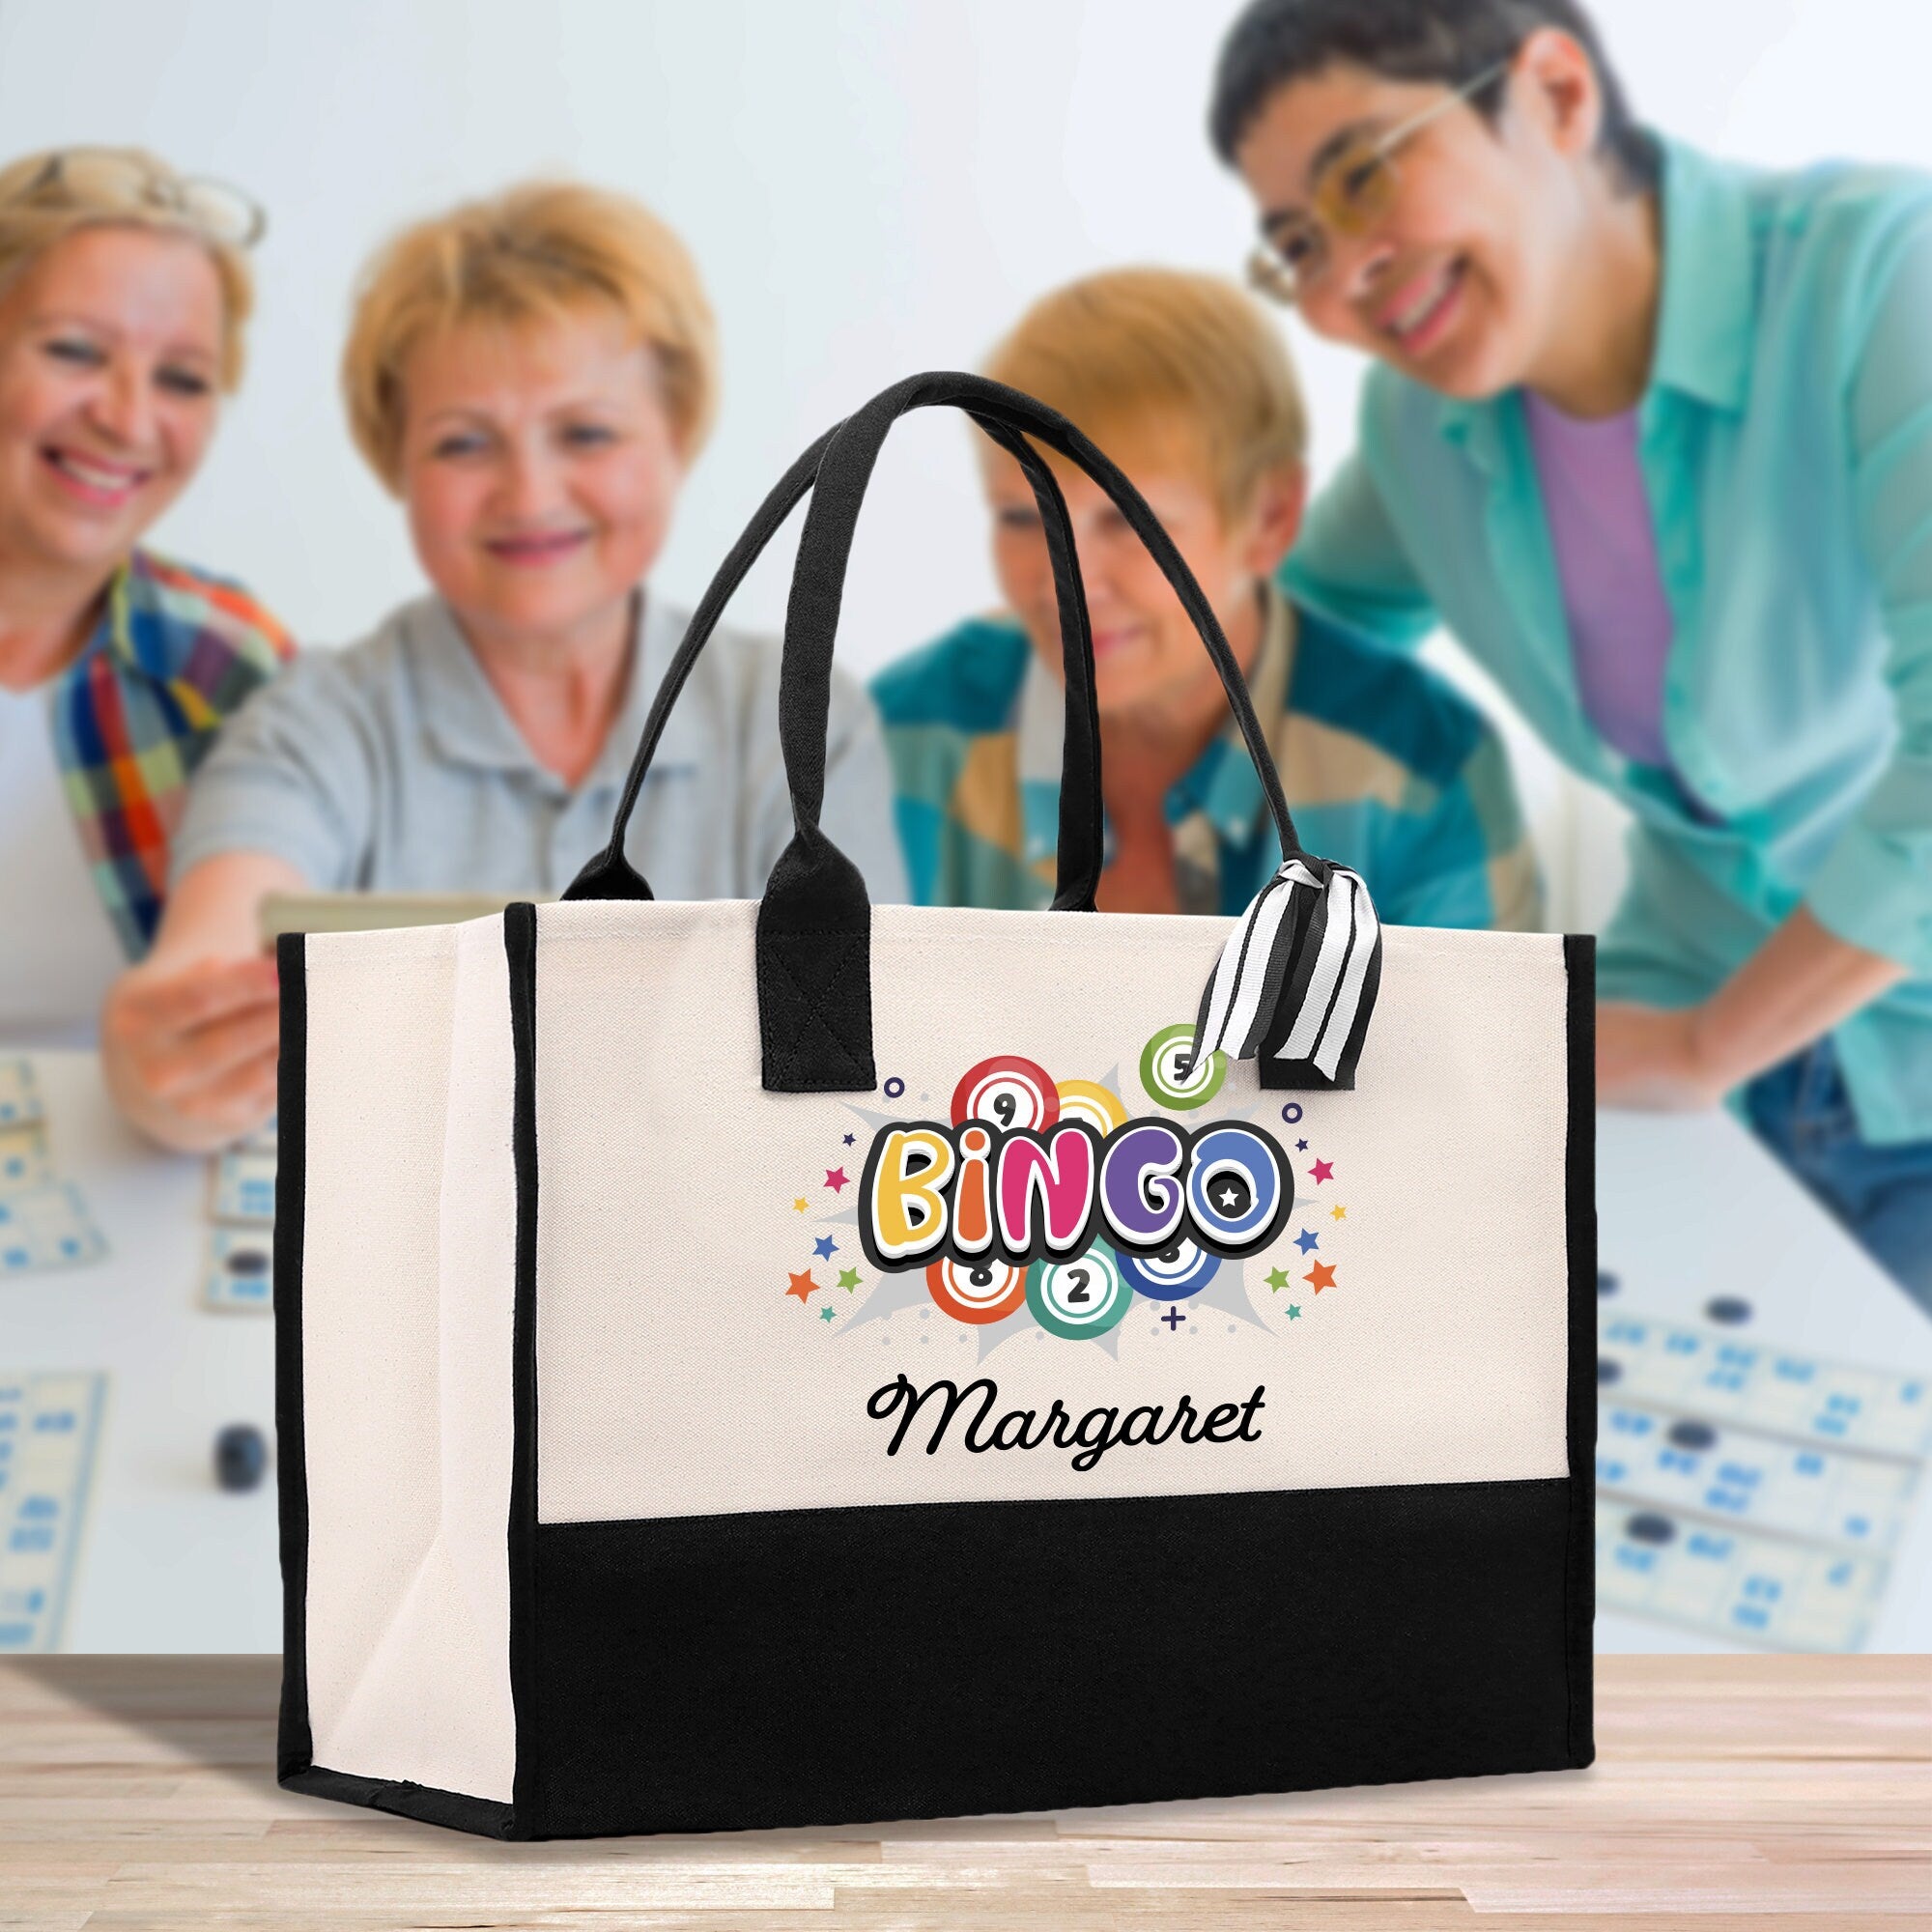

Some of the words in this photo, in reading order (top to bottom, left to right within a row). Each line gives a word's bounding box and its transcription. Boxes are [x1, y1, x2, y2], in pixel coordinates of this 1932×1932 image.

[993, 1093, 1017, 1127] 9
[1066, 1268, 1091, 1303] 2
[867, 1373, 1265, 1472] Margaret
